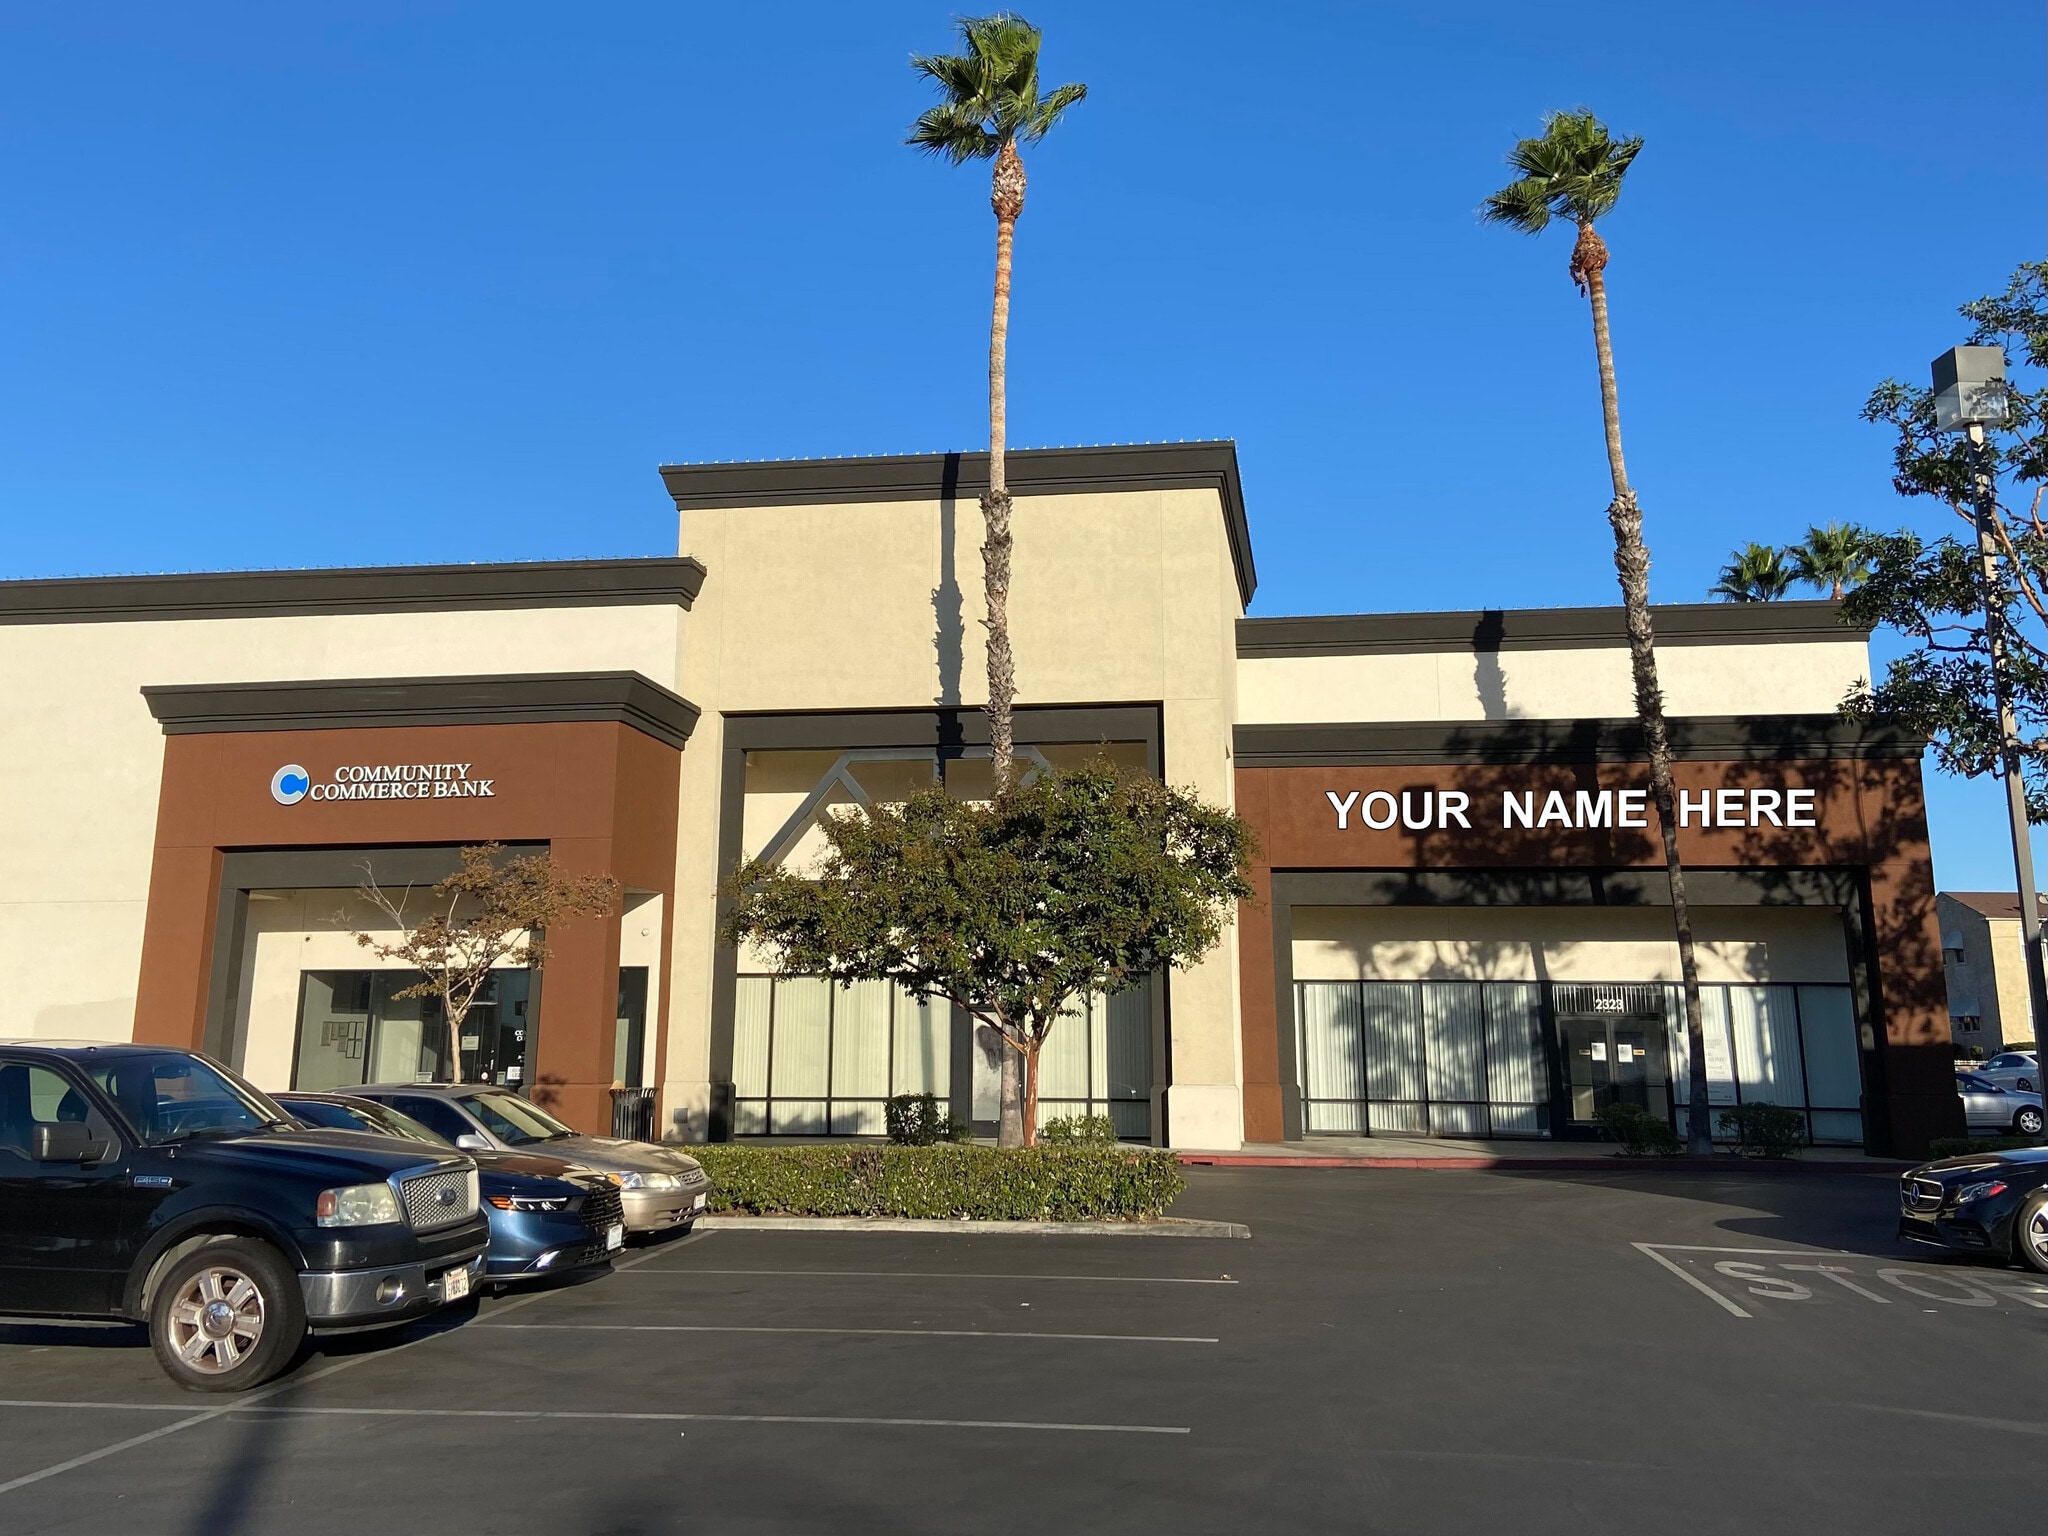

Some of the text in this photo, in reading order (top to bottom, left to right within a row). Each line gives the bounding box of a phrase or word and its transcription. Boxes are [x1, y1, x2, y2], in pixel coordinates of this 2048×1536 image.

[335, 763, 472, 783] COMMUNITY
[310, 780, 496, 801] COMMERCE BANK
[1325, 788, 1818, 830] YOUR NAME HERE
[1595, 998, 1624, 1010] 2323
[1713, 1260, 2048, 1309] STOP
